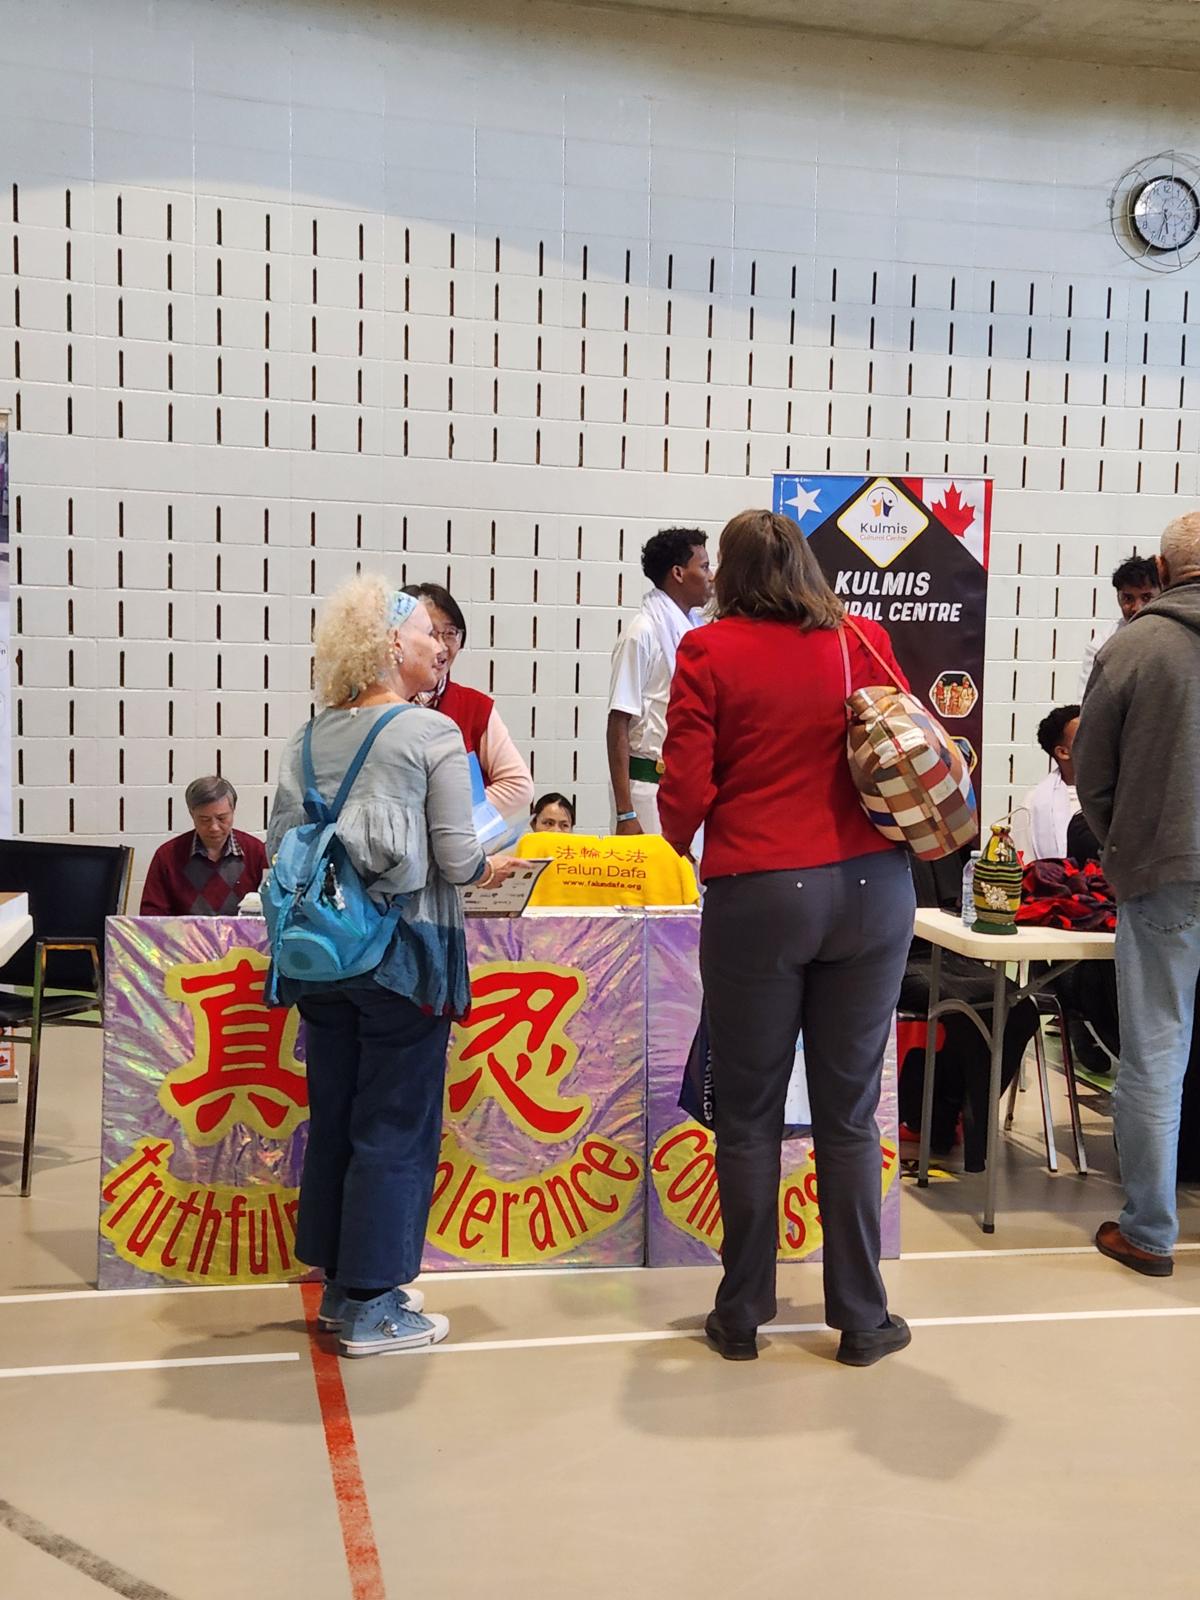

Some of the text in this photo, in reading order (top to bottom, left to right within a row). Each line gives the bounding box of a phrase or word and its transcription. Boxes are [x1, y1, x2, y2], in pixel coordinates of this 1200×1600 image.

[860, 522, 908, 534] Kulmis
[834, 570, 931, 597] KULMIS
[888, 601, 963, 623] CENTRE
[556, 863, 646, 879] Falun Dafa
[562, 880, 642, 891] www.falundafa.org
[430, 1134, 640, 1258] olerance
